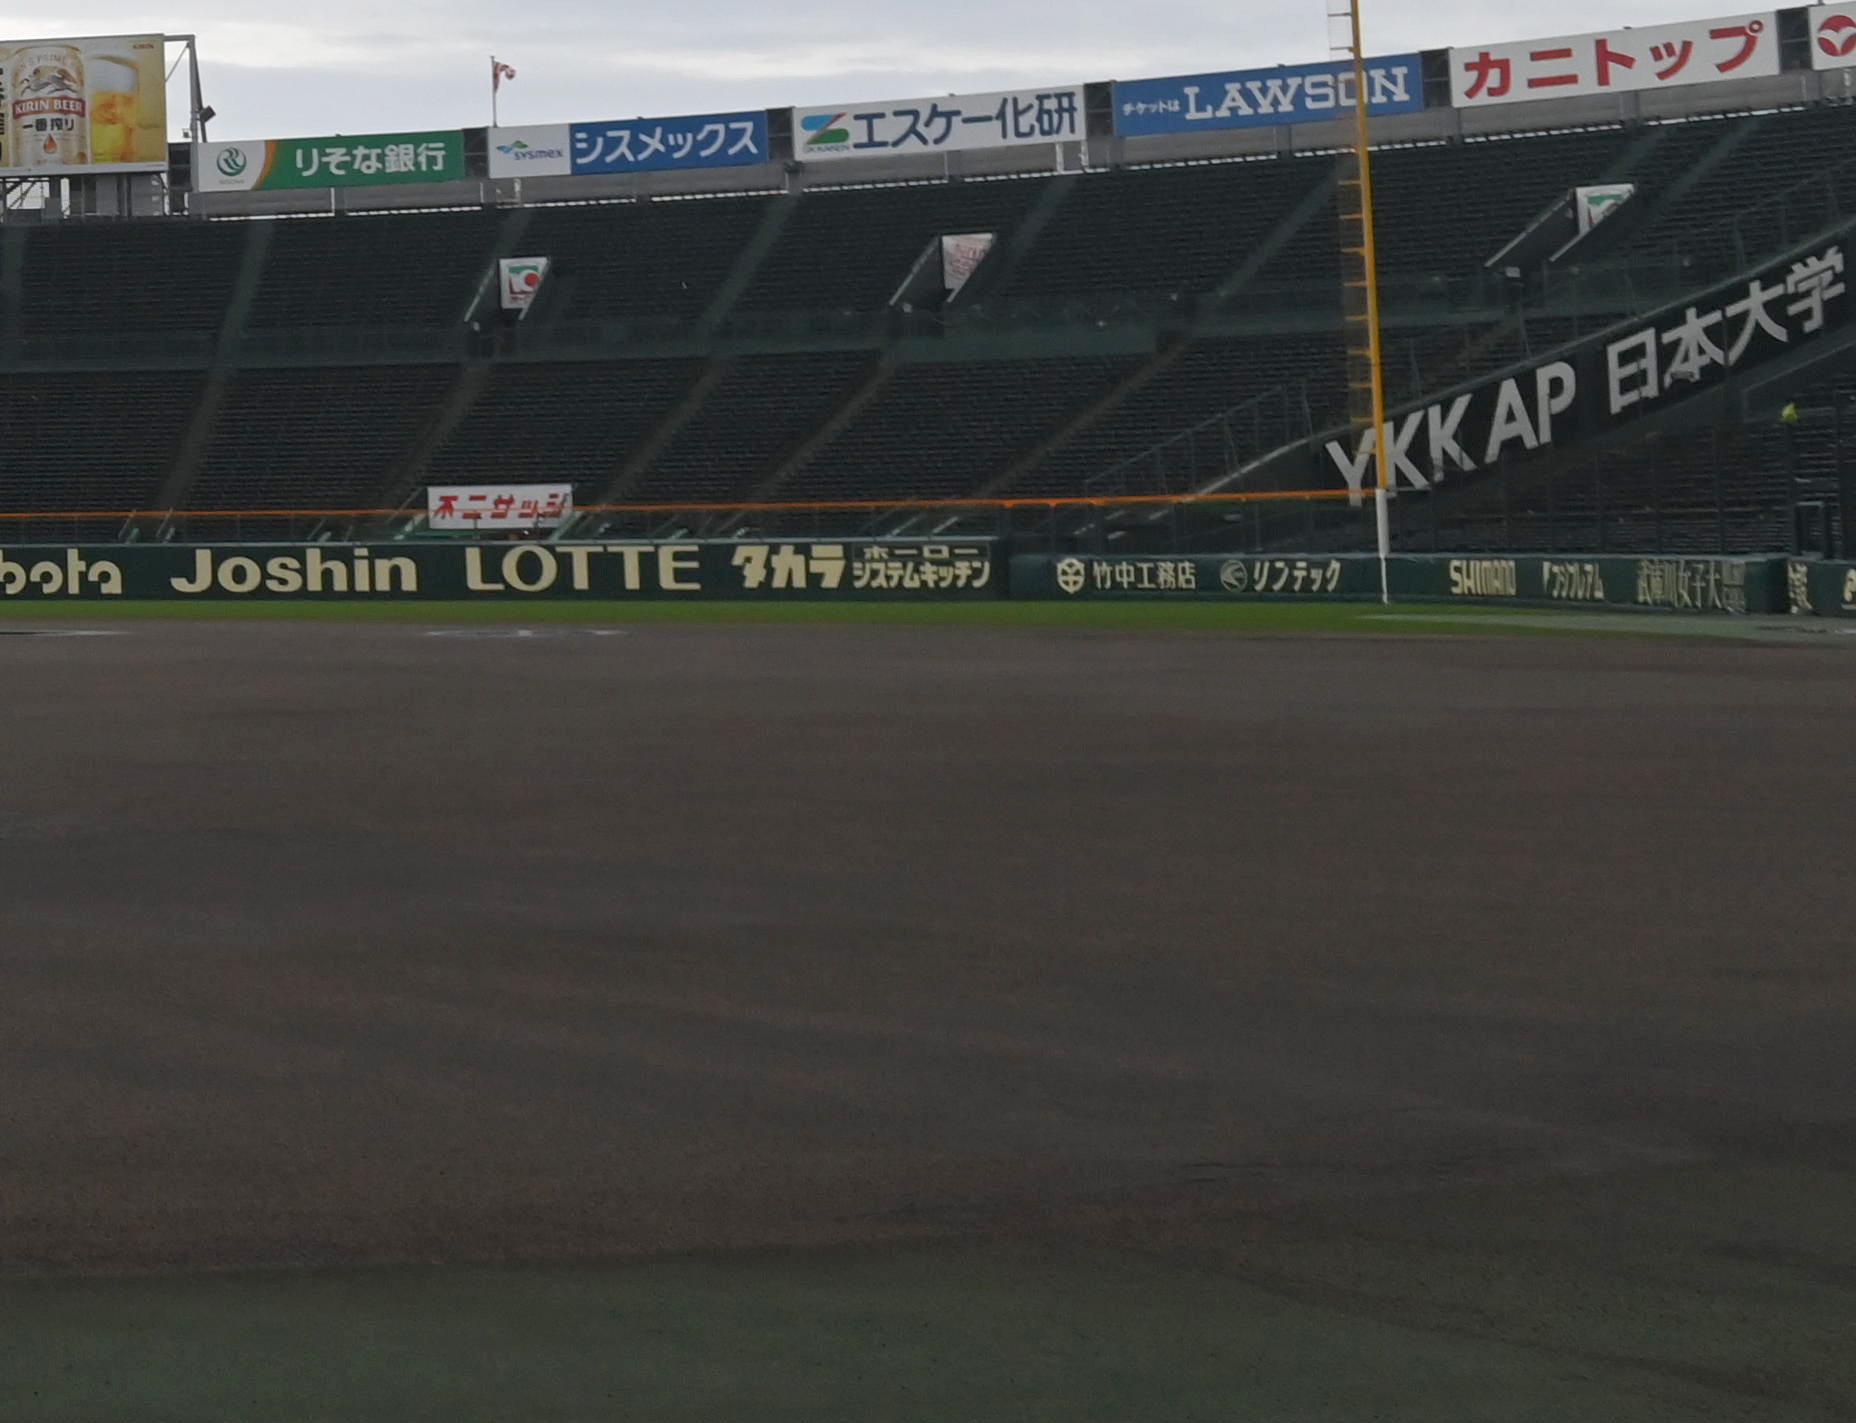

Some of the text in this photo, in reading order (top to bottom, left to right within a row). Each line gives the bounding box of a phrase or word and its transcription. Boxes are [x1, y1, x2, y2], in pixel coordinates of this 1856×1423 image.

[1464, 20, 1764, 99] カニトップ
[15, 98, 84, 114] KIRIN BEER
[1183, 66, 1391, 120] LAWSON
[574, 121, 759, 164] シスメックス
[852, 92, 1078, 150] エスケー化研
[295, 142, 447, 177] りそな銀行
[1606, 244, 1846, 415] 日本大学
[170, 548, 419, 593] Joshin
[464, 544, 702, 592] LOTTE
[731, 544, 848, 589] タカラ
[852, 559, 991, 590] システムキッチン
[863, 545, 979, 561] ホーロー
[1092, 559, 1197, 590] 竹中工務店
